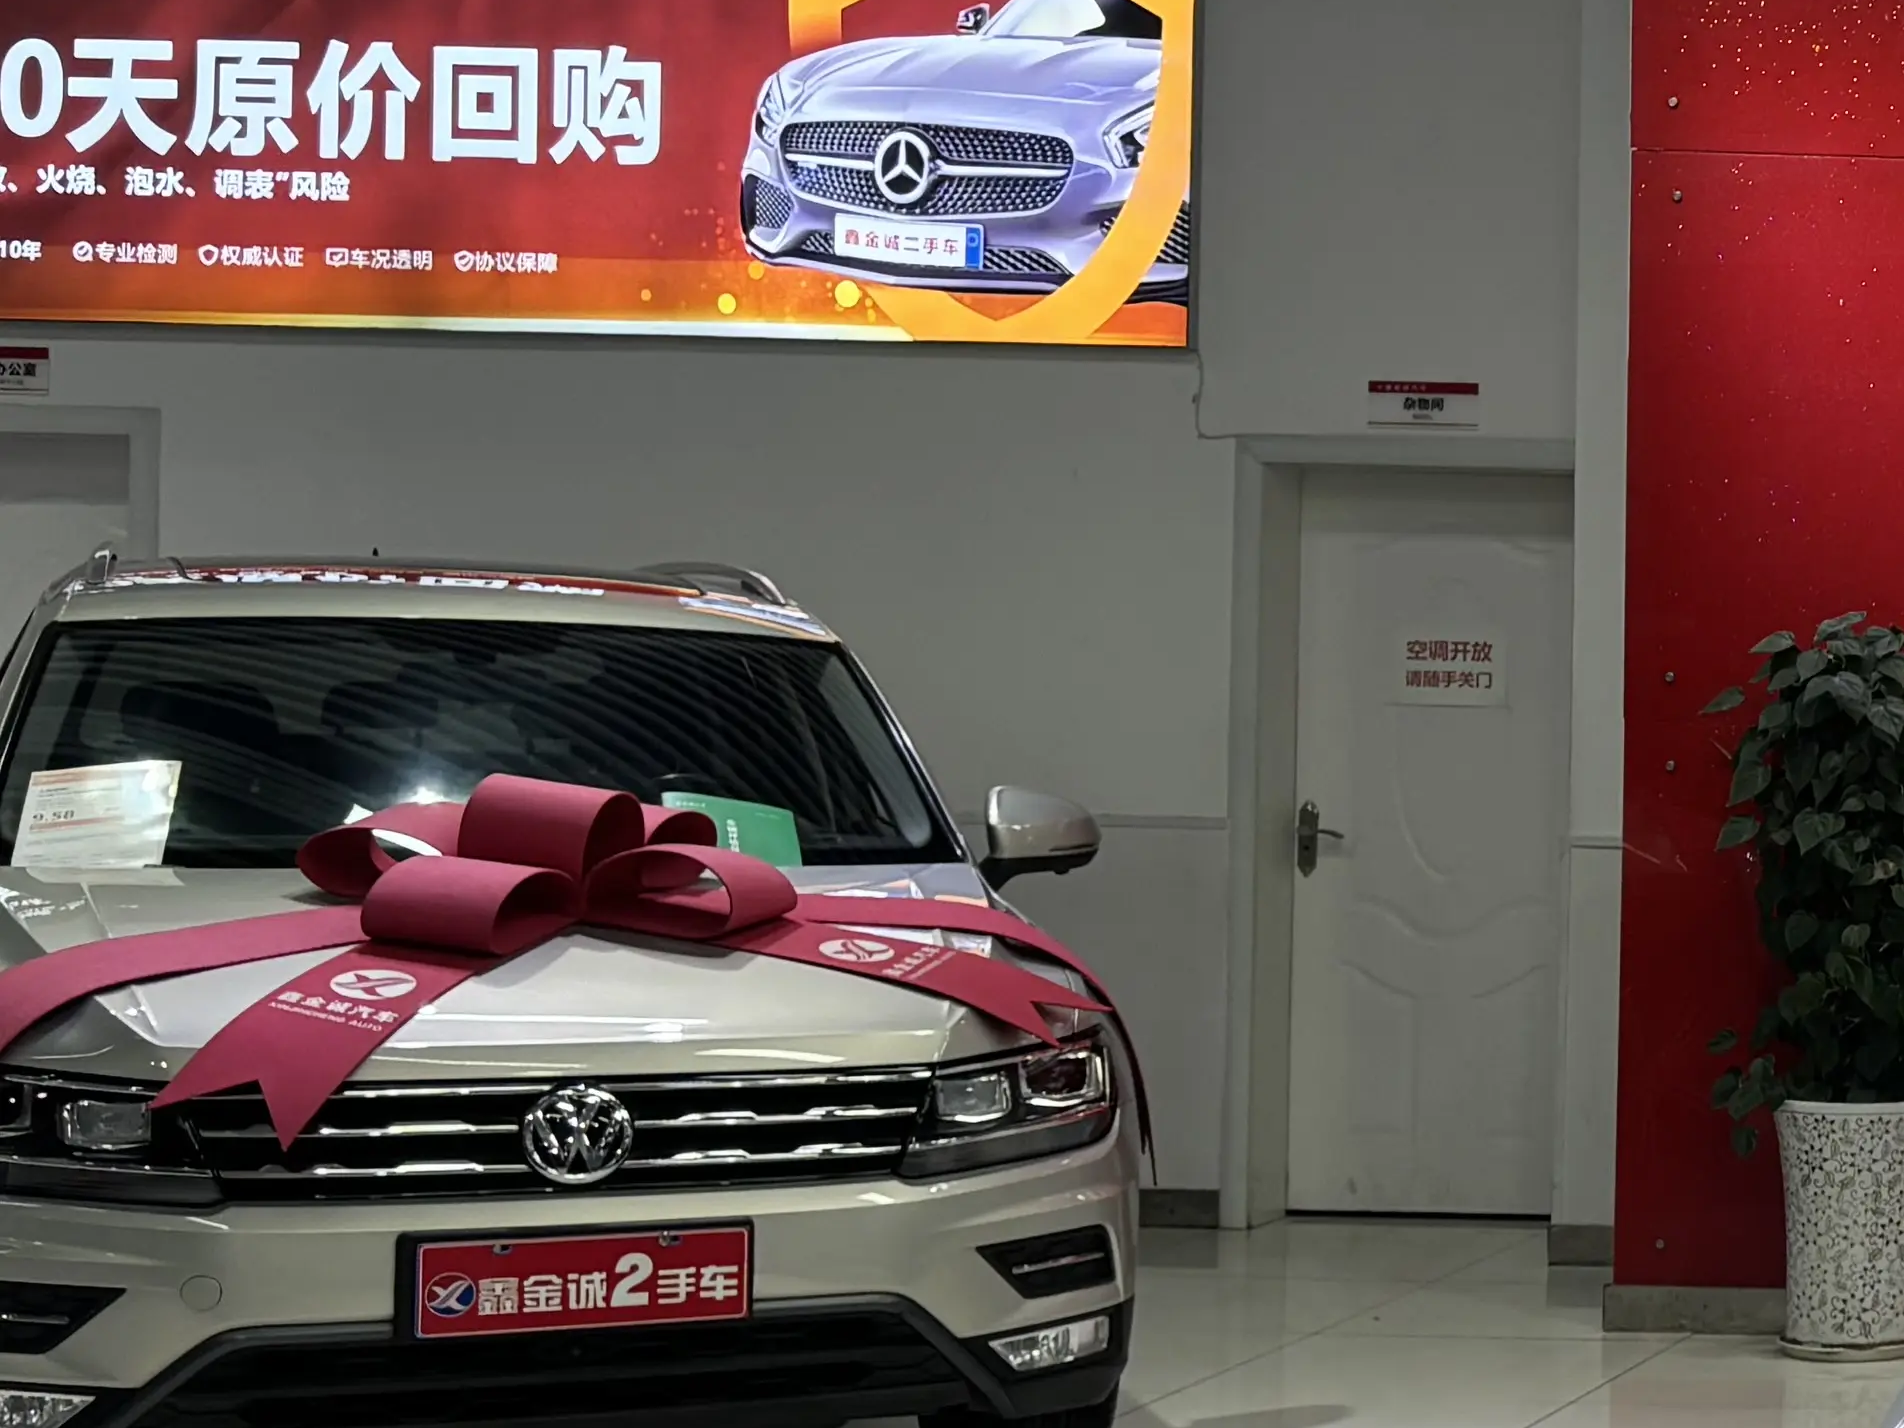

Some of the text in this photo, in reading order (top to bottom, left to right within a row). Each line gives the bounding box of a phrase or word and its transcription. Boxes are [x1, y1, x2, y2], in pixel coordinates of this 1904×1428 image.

[1, 38, 663, 165] 0天原价回购
[96, 242, 178, 264] 专业检测
[220, 246, 304, 267] 权威认证
[350, 249, 433, 270] 车况透明
[475, 252, 558, 274] 协议保障
[1406, 640, 1493, 663] 空调开放
[1405, 670, 1493, 689] 请随手关门
[478, 1252, 739, 1316] 鑫金诚2手车
